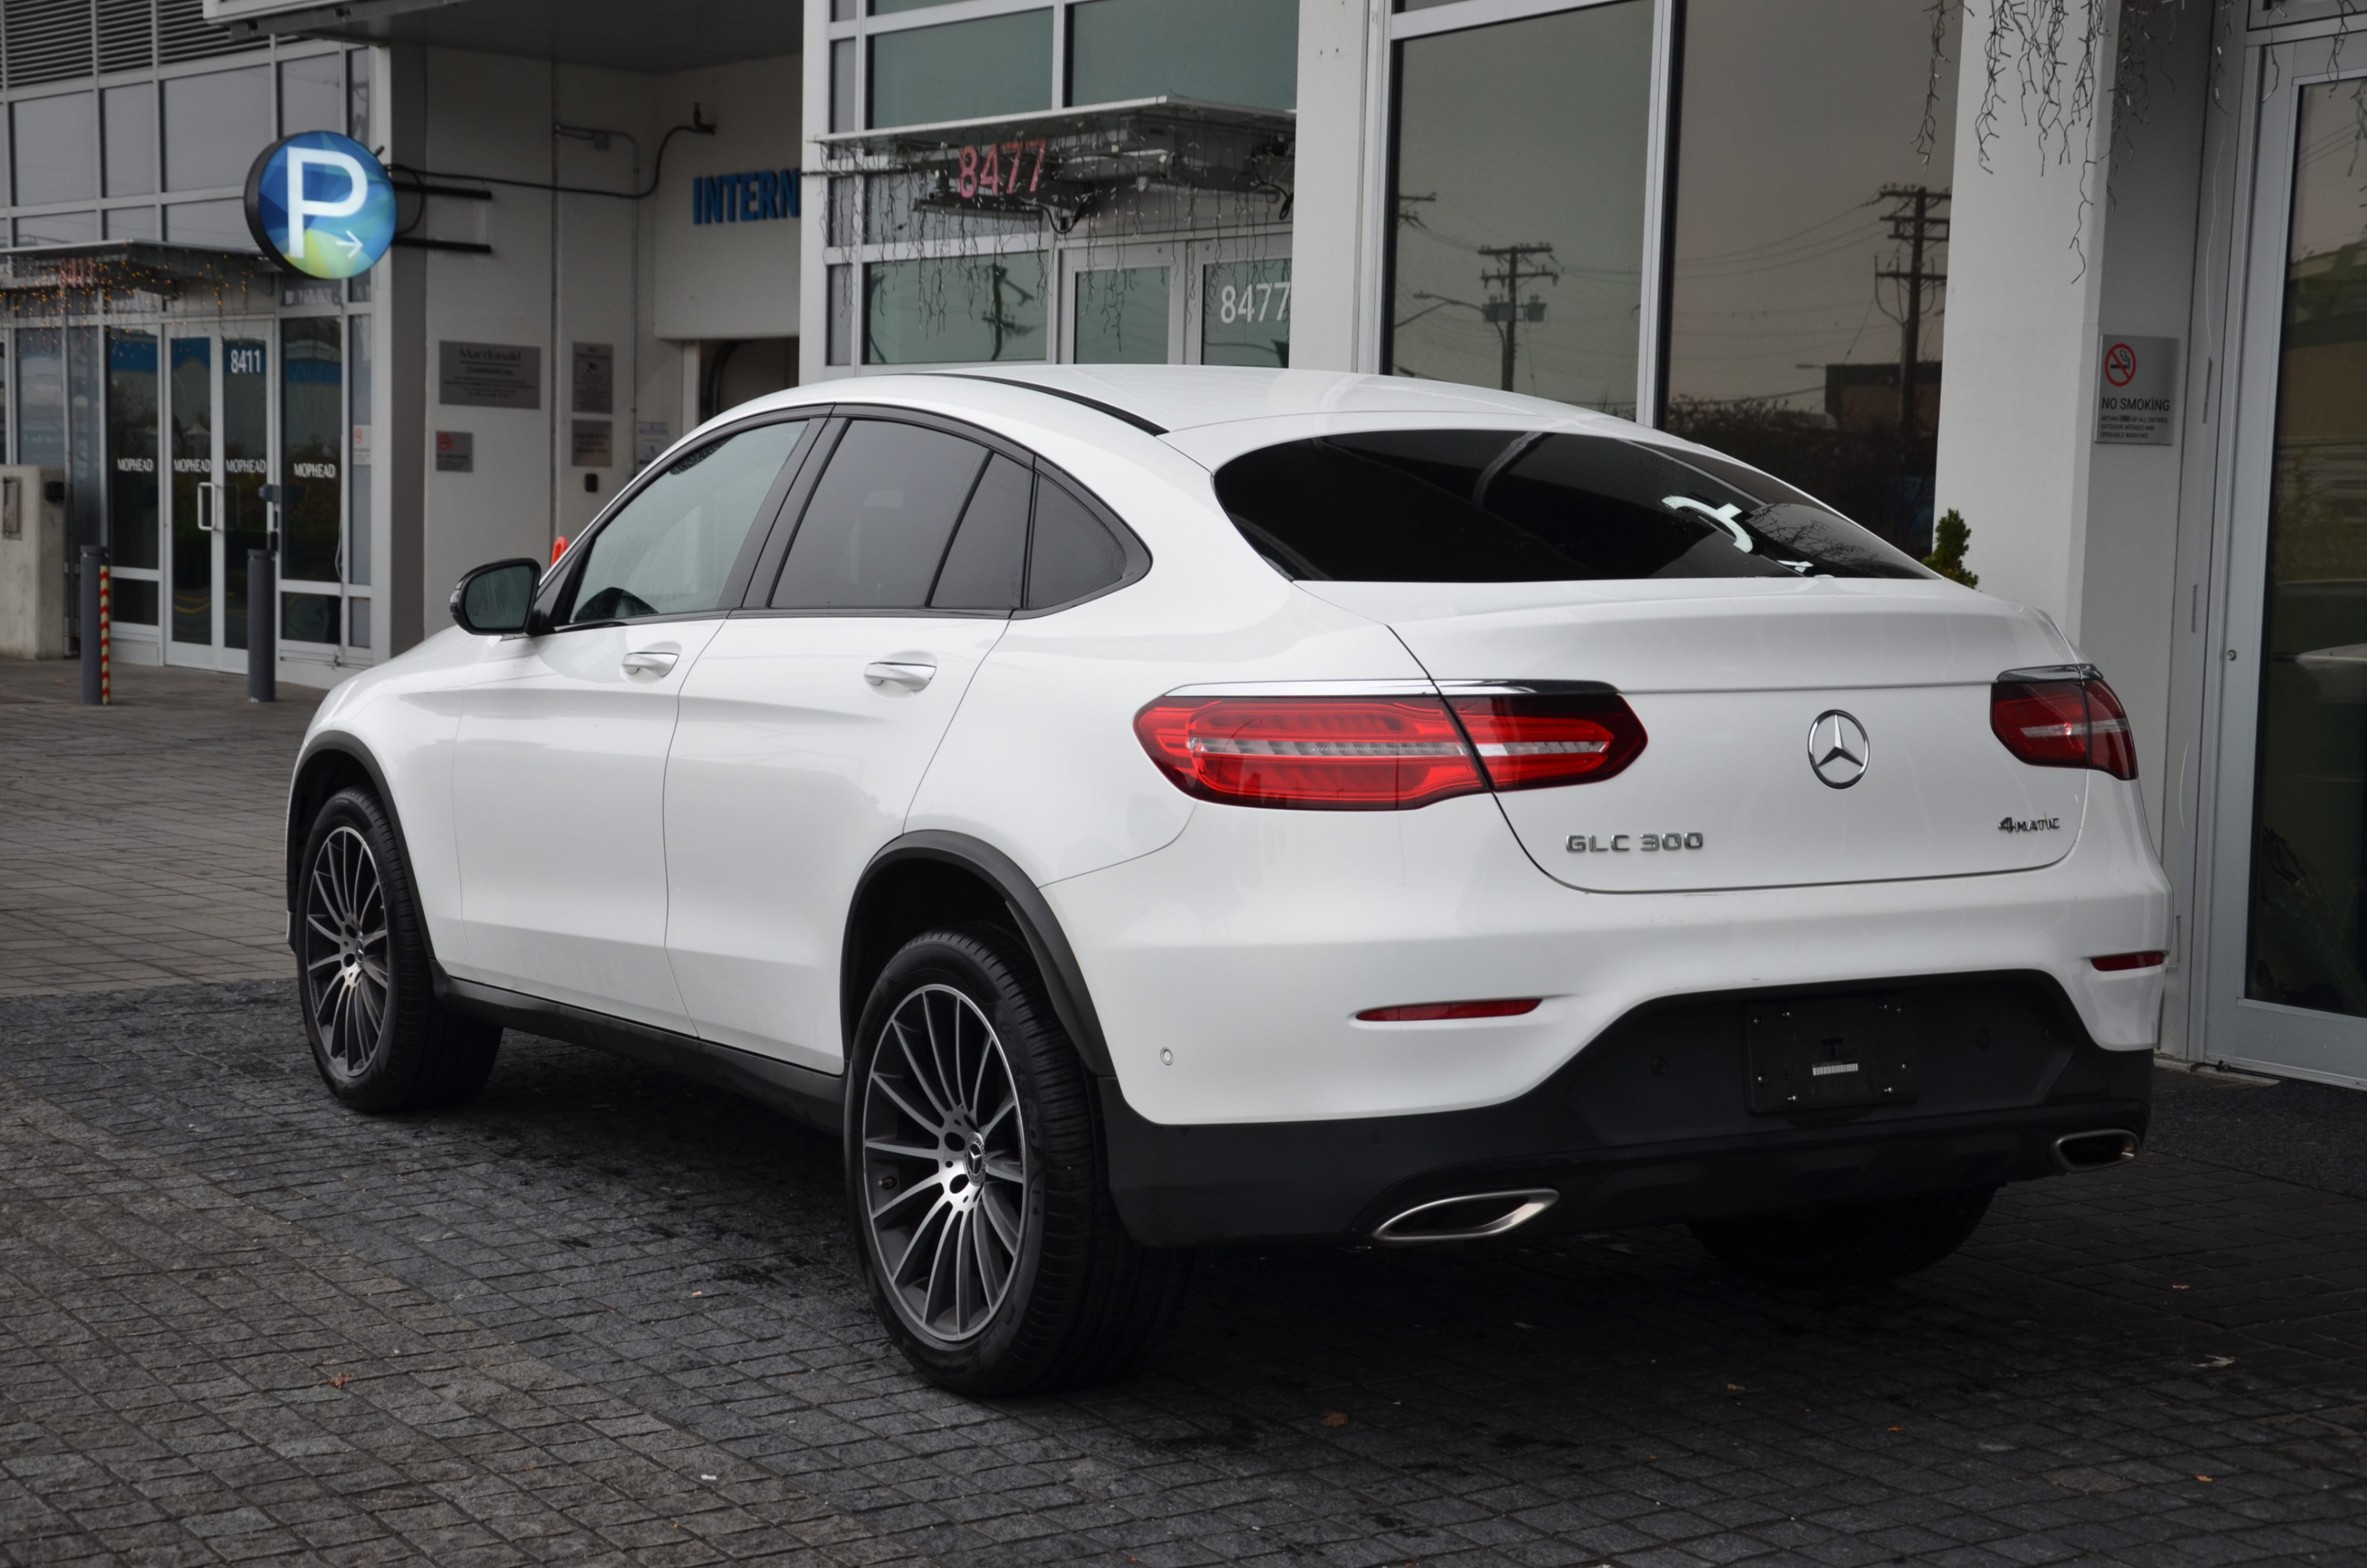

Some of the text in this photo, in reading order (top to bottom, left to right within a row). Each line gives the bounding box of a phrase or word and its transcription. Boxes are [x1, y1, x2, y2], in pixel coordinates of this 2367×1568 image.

[960, 139, 1046, 198] 8477
[287, 146, 368, 258] P
[693, 168, 801, 225] INTERN
[1221, 281, 1291, 323] 8477
[231, 349, 261, 374] 8411
[2101, 397, 2170, 411] NO SMOKING
[117, 458, 153, 472] MOPHEAD
[173, 459, 211, 472] MOPHEAD
[225, 459, 266, 473] MOPHEAD
[294, 463, 336, 479] MOPHEAD
[1998, 817, 2060, 833] 4MATIC
[1566, 832, 1703, 853] GLC 300
